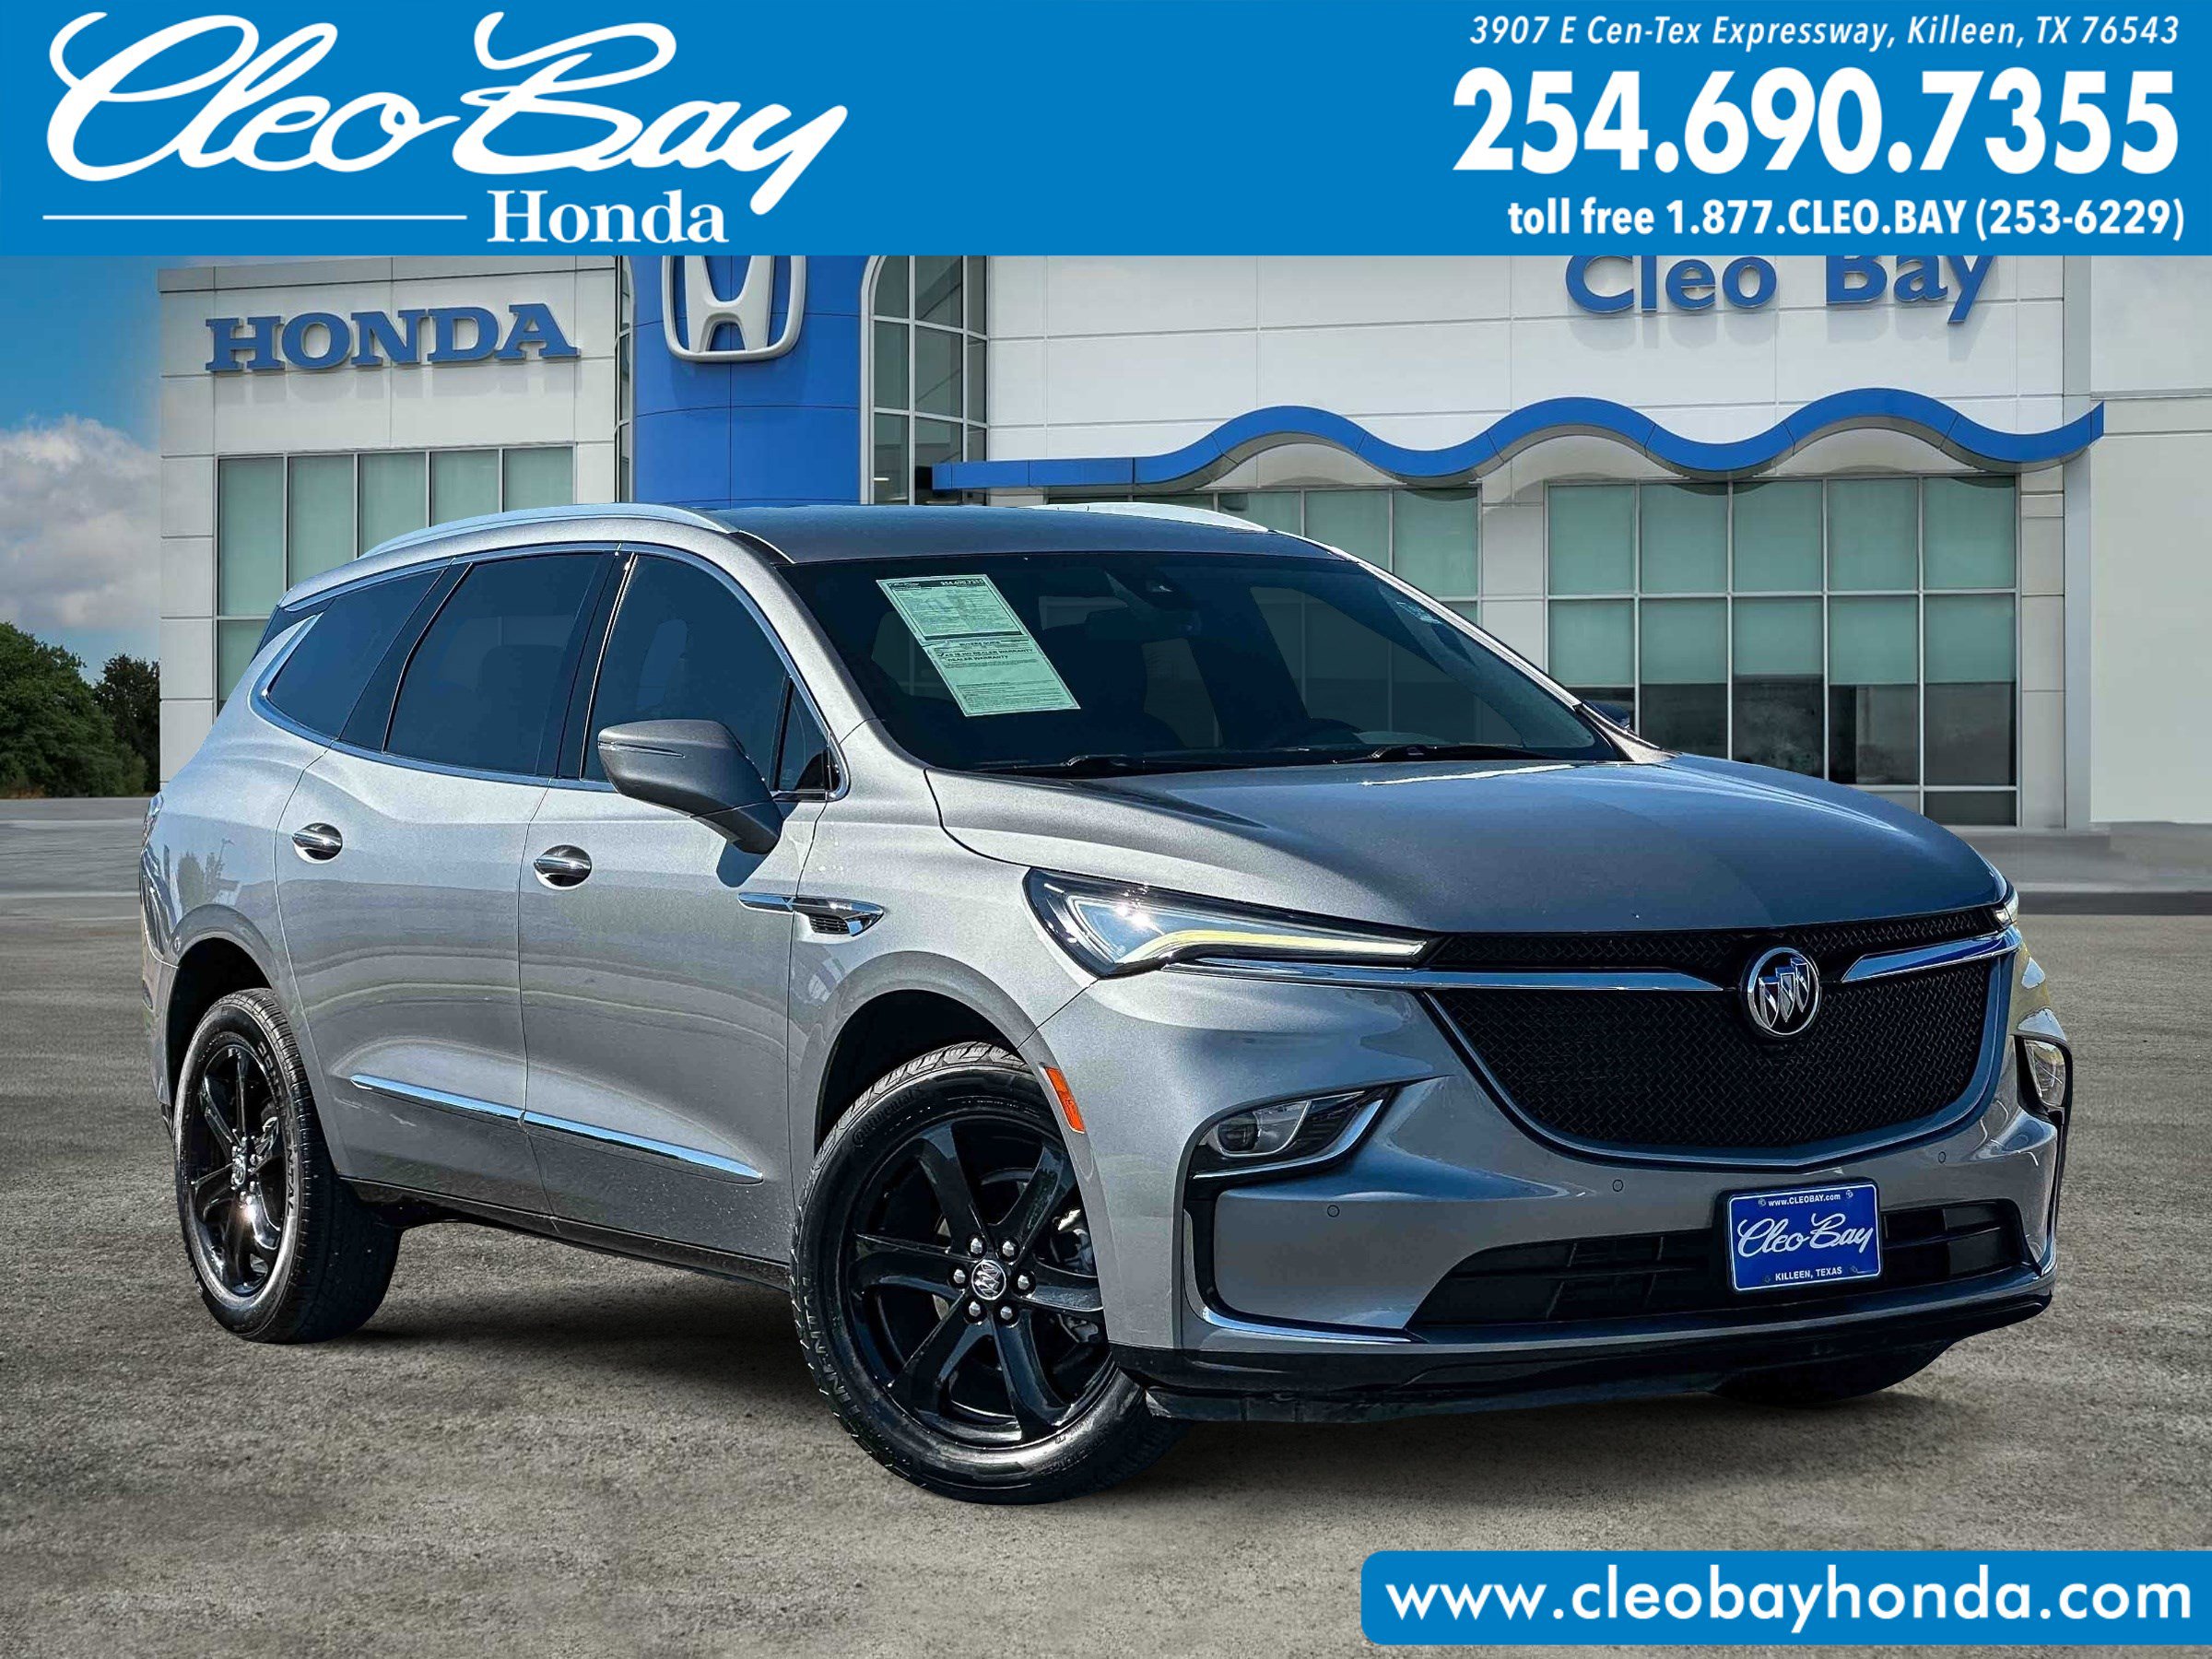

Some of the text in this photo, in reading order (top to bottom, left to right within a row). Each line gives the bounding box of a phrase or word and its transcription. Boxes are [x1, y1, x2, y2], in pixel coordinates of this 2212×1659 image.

[1566, 255, 1995, 324] Cleo Bay
[206, 303, 582, 372] HONDA
[1768, 1194, 1841, 1207] www.CLEOBAY.com
[1736, 1212, 1874, 1258] Cleo Bay
[1775, 1266, 1842, 1282] KILLEEN, TEXAS
